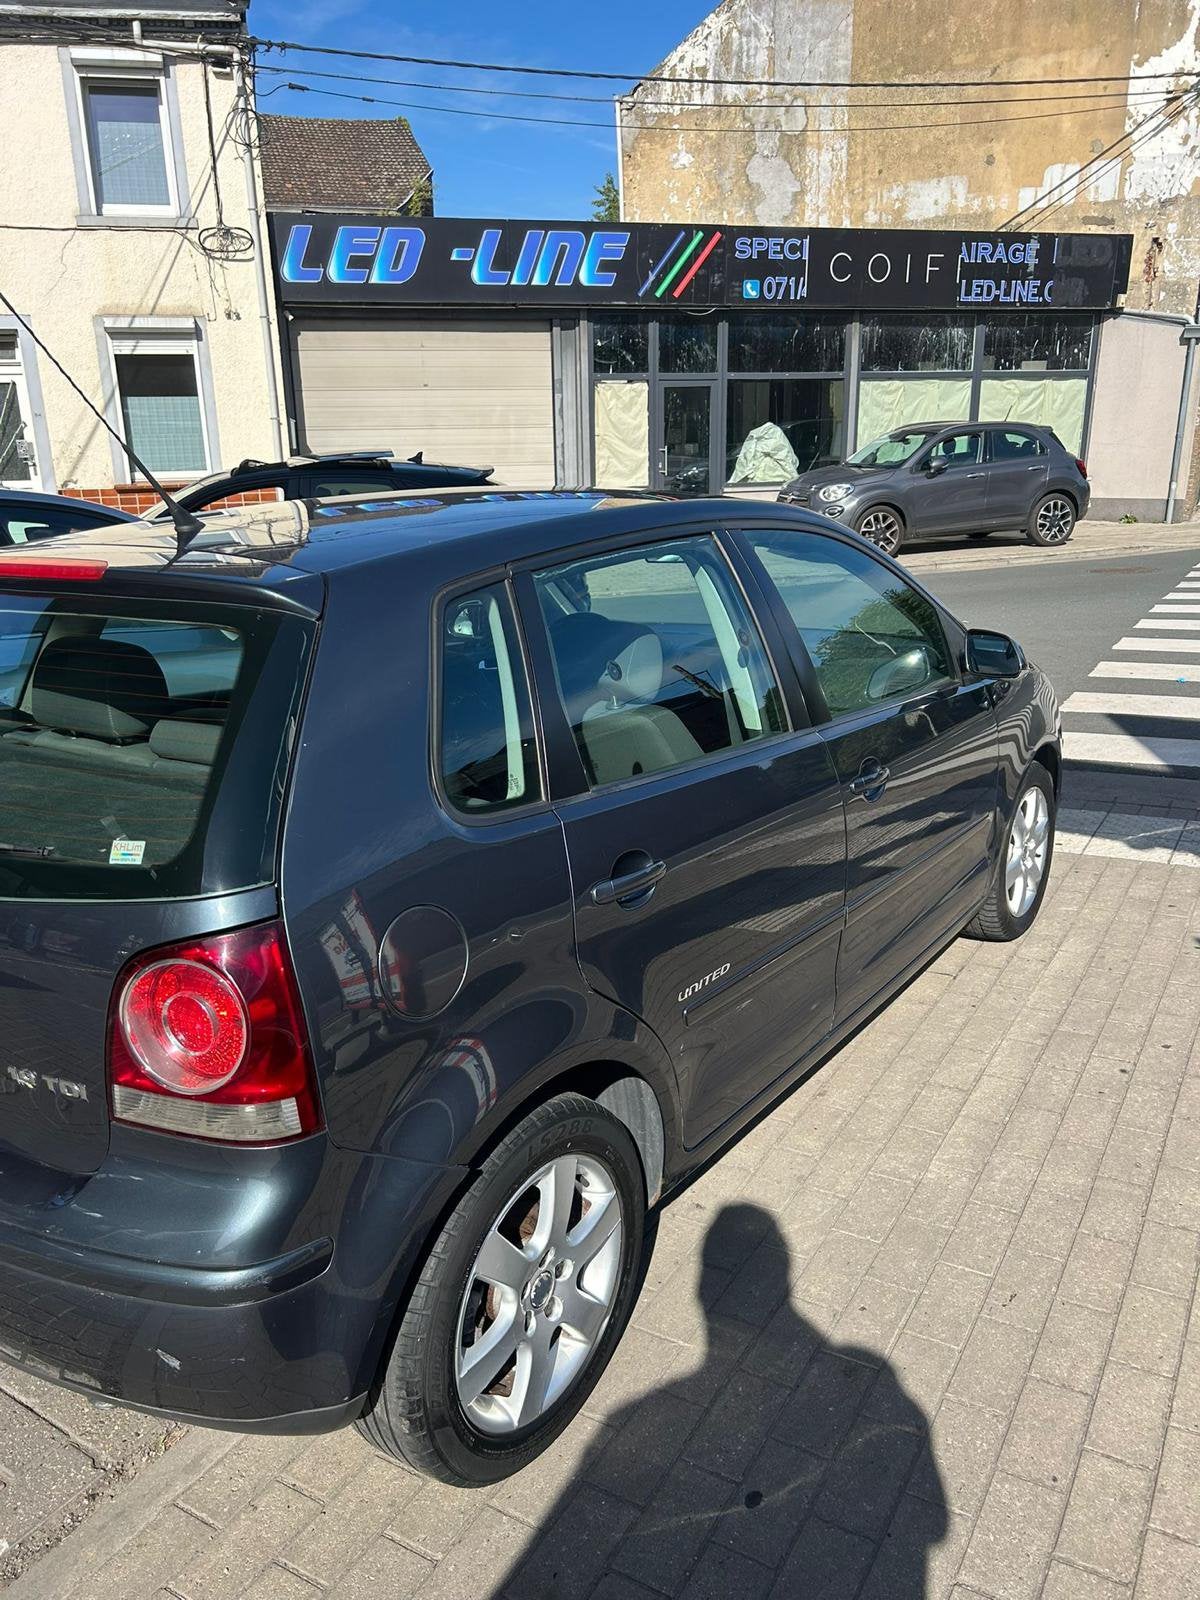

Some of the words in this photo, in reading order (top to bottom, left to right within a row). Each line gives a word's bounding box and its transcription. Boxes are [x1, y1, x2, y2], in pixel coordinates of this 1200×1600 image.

[280, 225, 426, 284] LED
[678, 962, 731, 1002] UNITED
[41, 1074, 90, 1104] TDI
